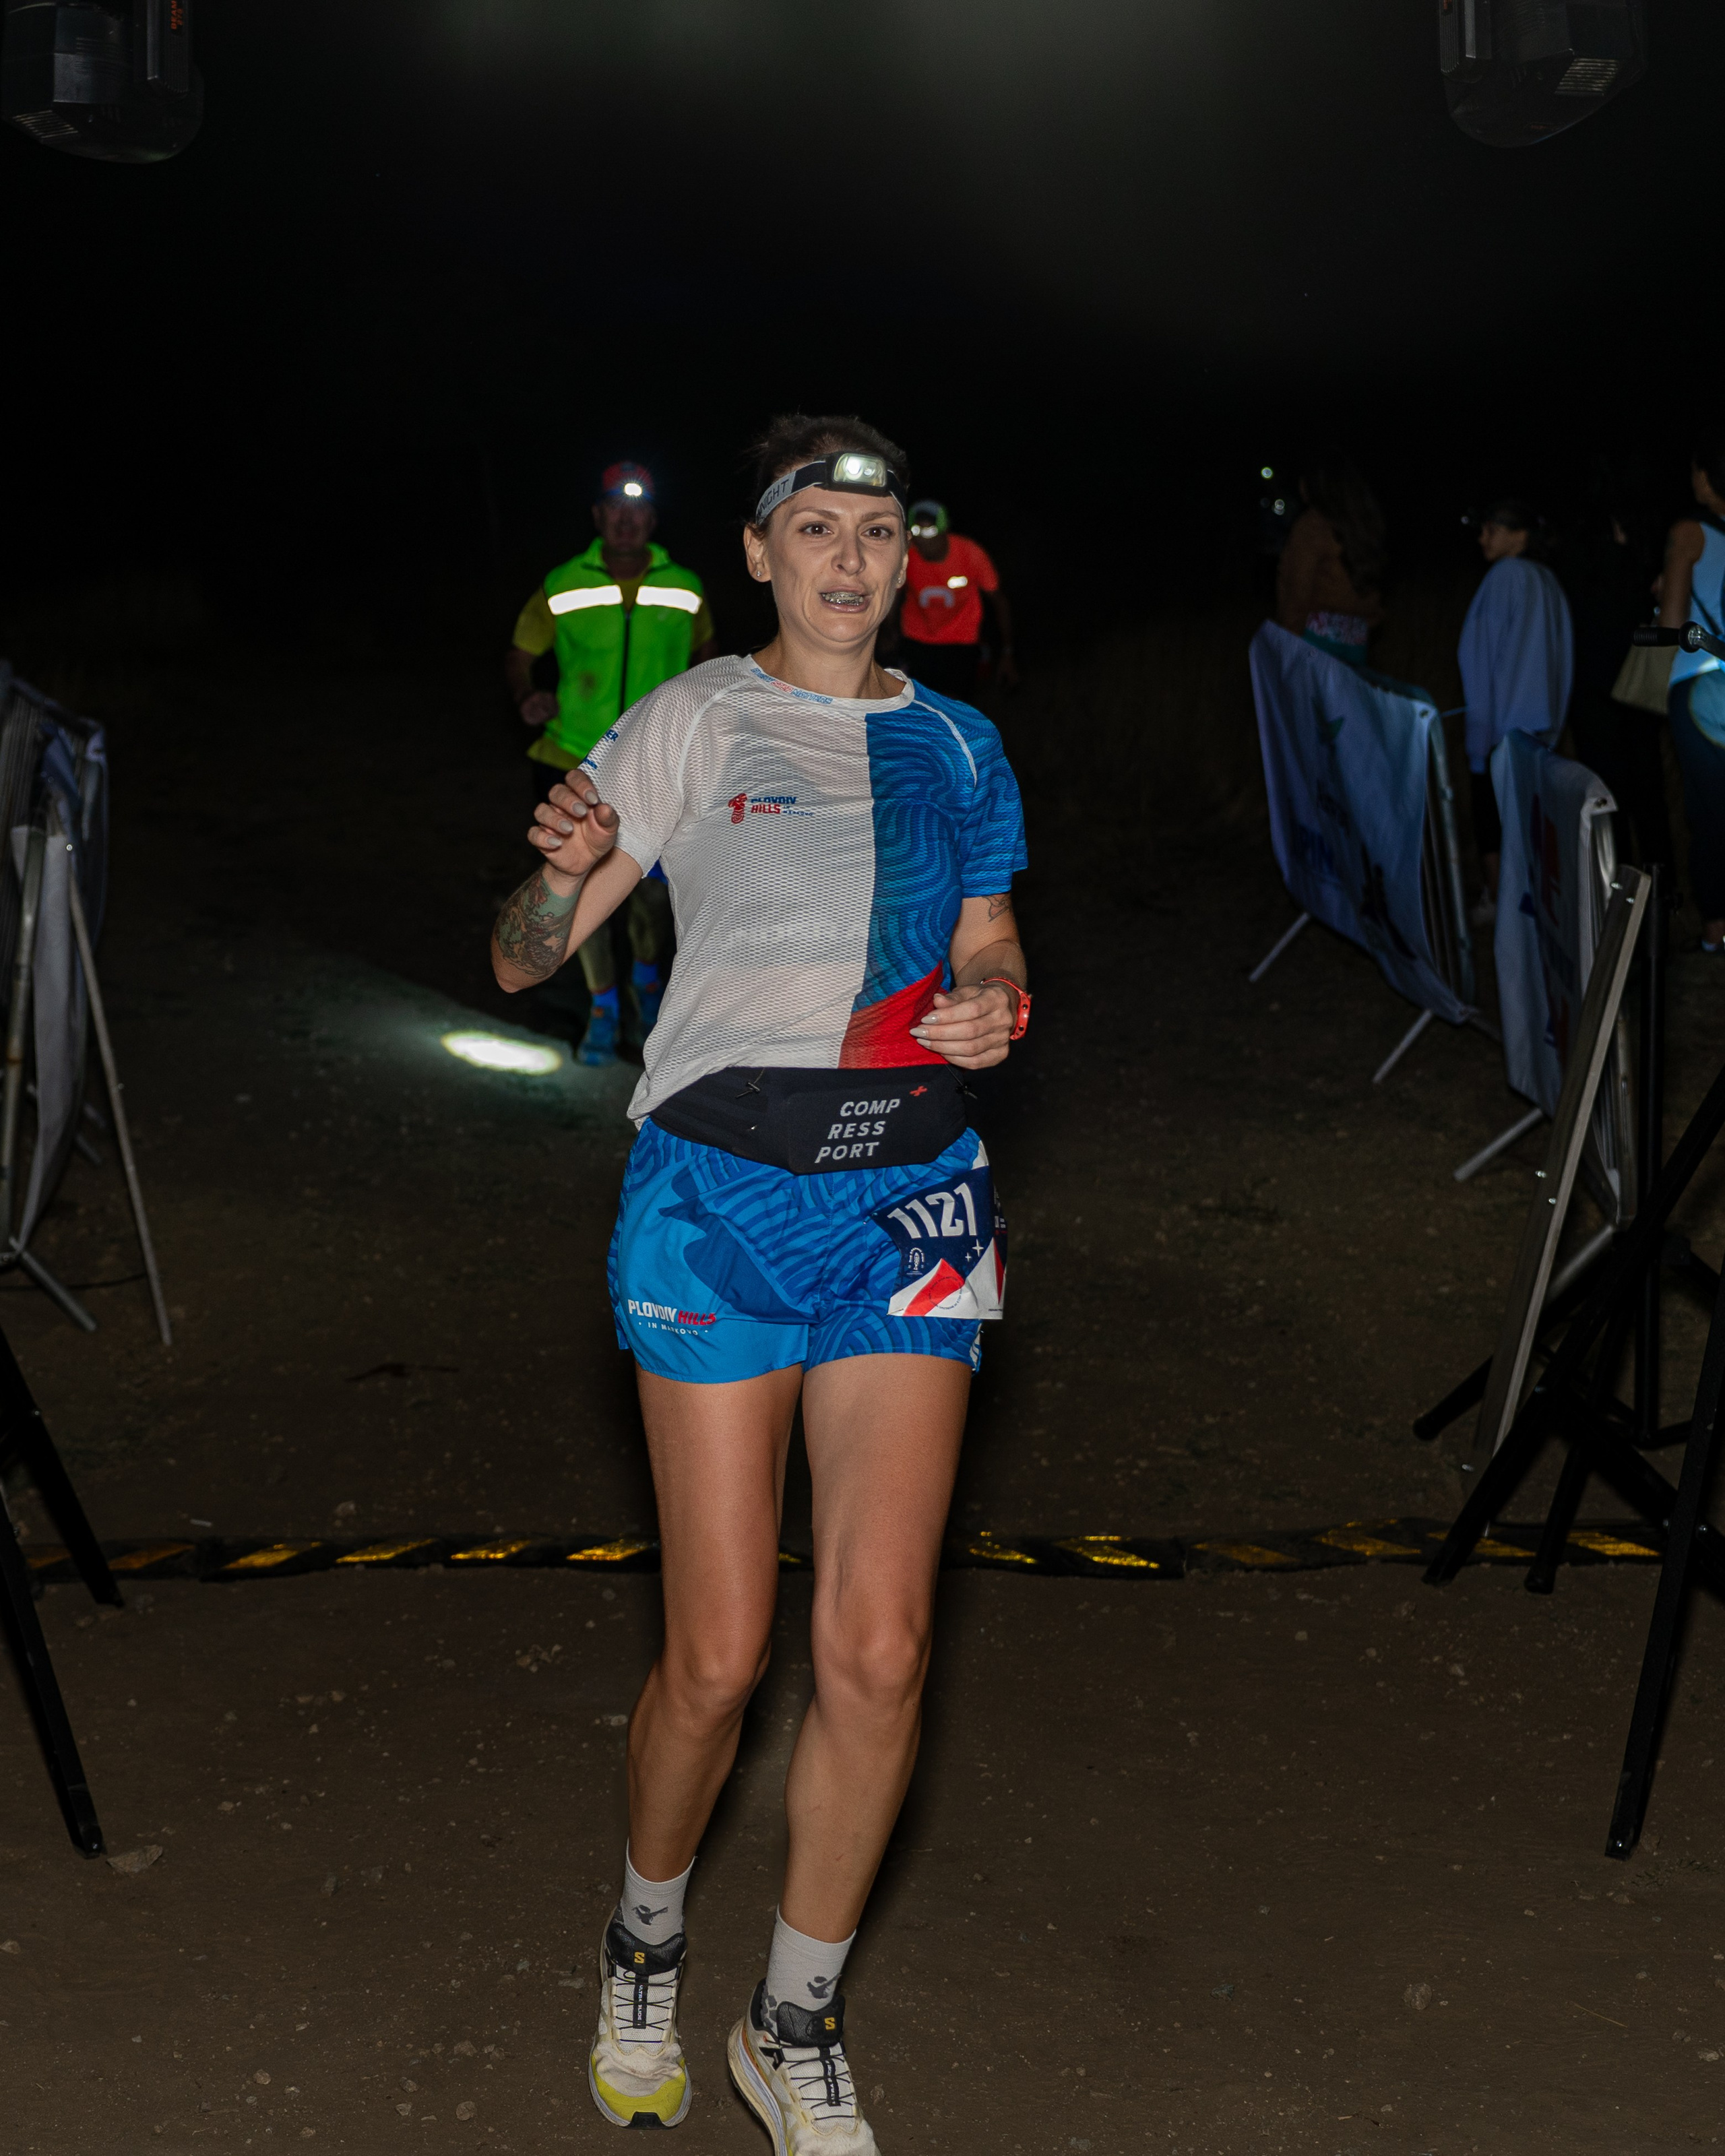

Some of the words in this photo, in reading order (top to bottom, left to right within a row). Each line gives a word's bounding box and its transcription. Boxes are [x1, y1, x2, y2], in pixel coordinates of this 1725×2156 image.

[770, 680, 794, 692] STEP
[791, 689, 833, 704] MATTERS
[751, 804, 781, 814] HILLS
[840, 1098, 900, 1116] COMP
[827, 1120, 886, 1139] RESS
[814, 1141, 879, 1163] PORT
[887, 1182, 977, 1239] 1121
[627, 1299, 677, 1323] PLOVDIV
[677, 1310, 716, 1326] HILLS
